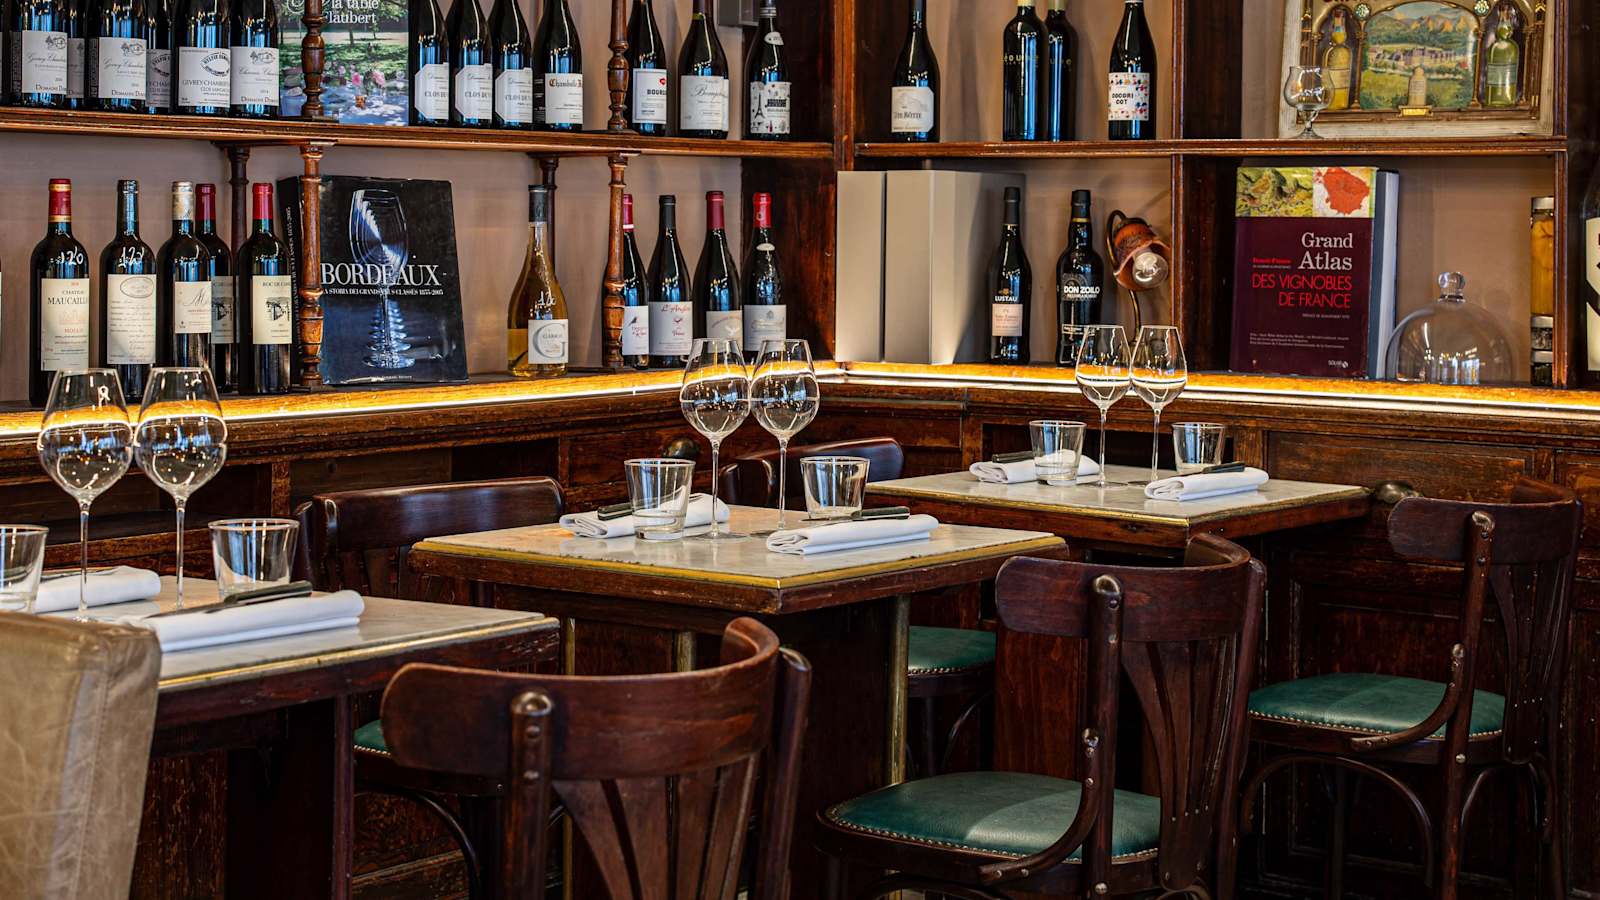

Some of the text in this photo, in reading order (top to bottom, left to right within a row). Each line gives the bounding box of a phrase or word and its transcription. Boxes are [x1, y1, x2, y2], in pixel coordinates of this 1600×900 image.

[1301, 232, 1353, 248] Grand
[1298, 251, 1353, 270] Atlas
[320, 262, 441, 286] BORDEAUX
[1252, 273, 1353, 291] DES VIGNOBLES
[1080, 286, 1100, 294] ZOILO
[1279, 291, 1351, 308] DE FRANCE
